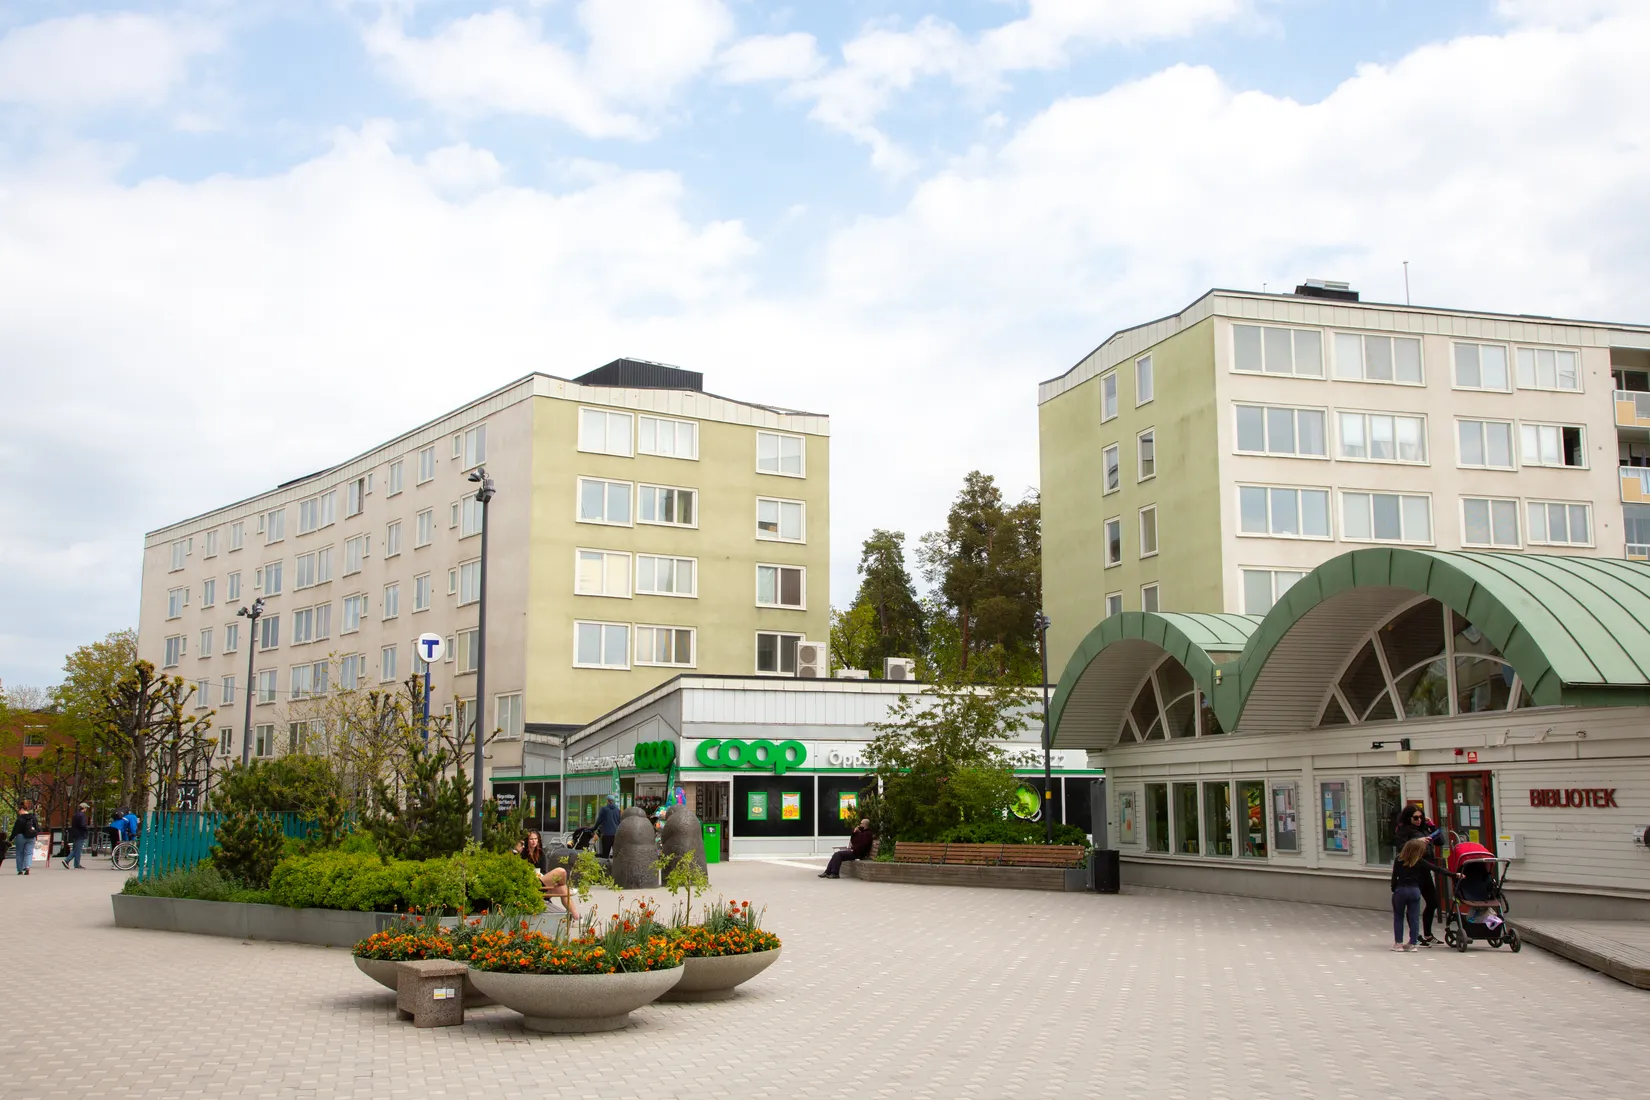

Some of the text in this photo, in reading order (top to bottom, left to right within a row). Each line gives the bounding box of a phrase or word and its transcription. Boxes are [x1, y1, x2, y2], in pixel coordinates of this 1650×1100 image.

[422, 640, 439, 658] T
[696, 739, 807, 775] coop
[829, 749, 876, 768] Öppe
[1529, 788, 1618, 808] BIBLIOTEK
